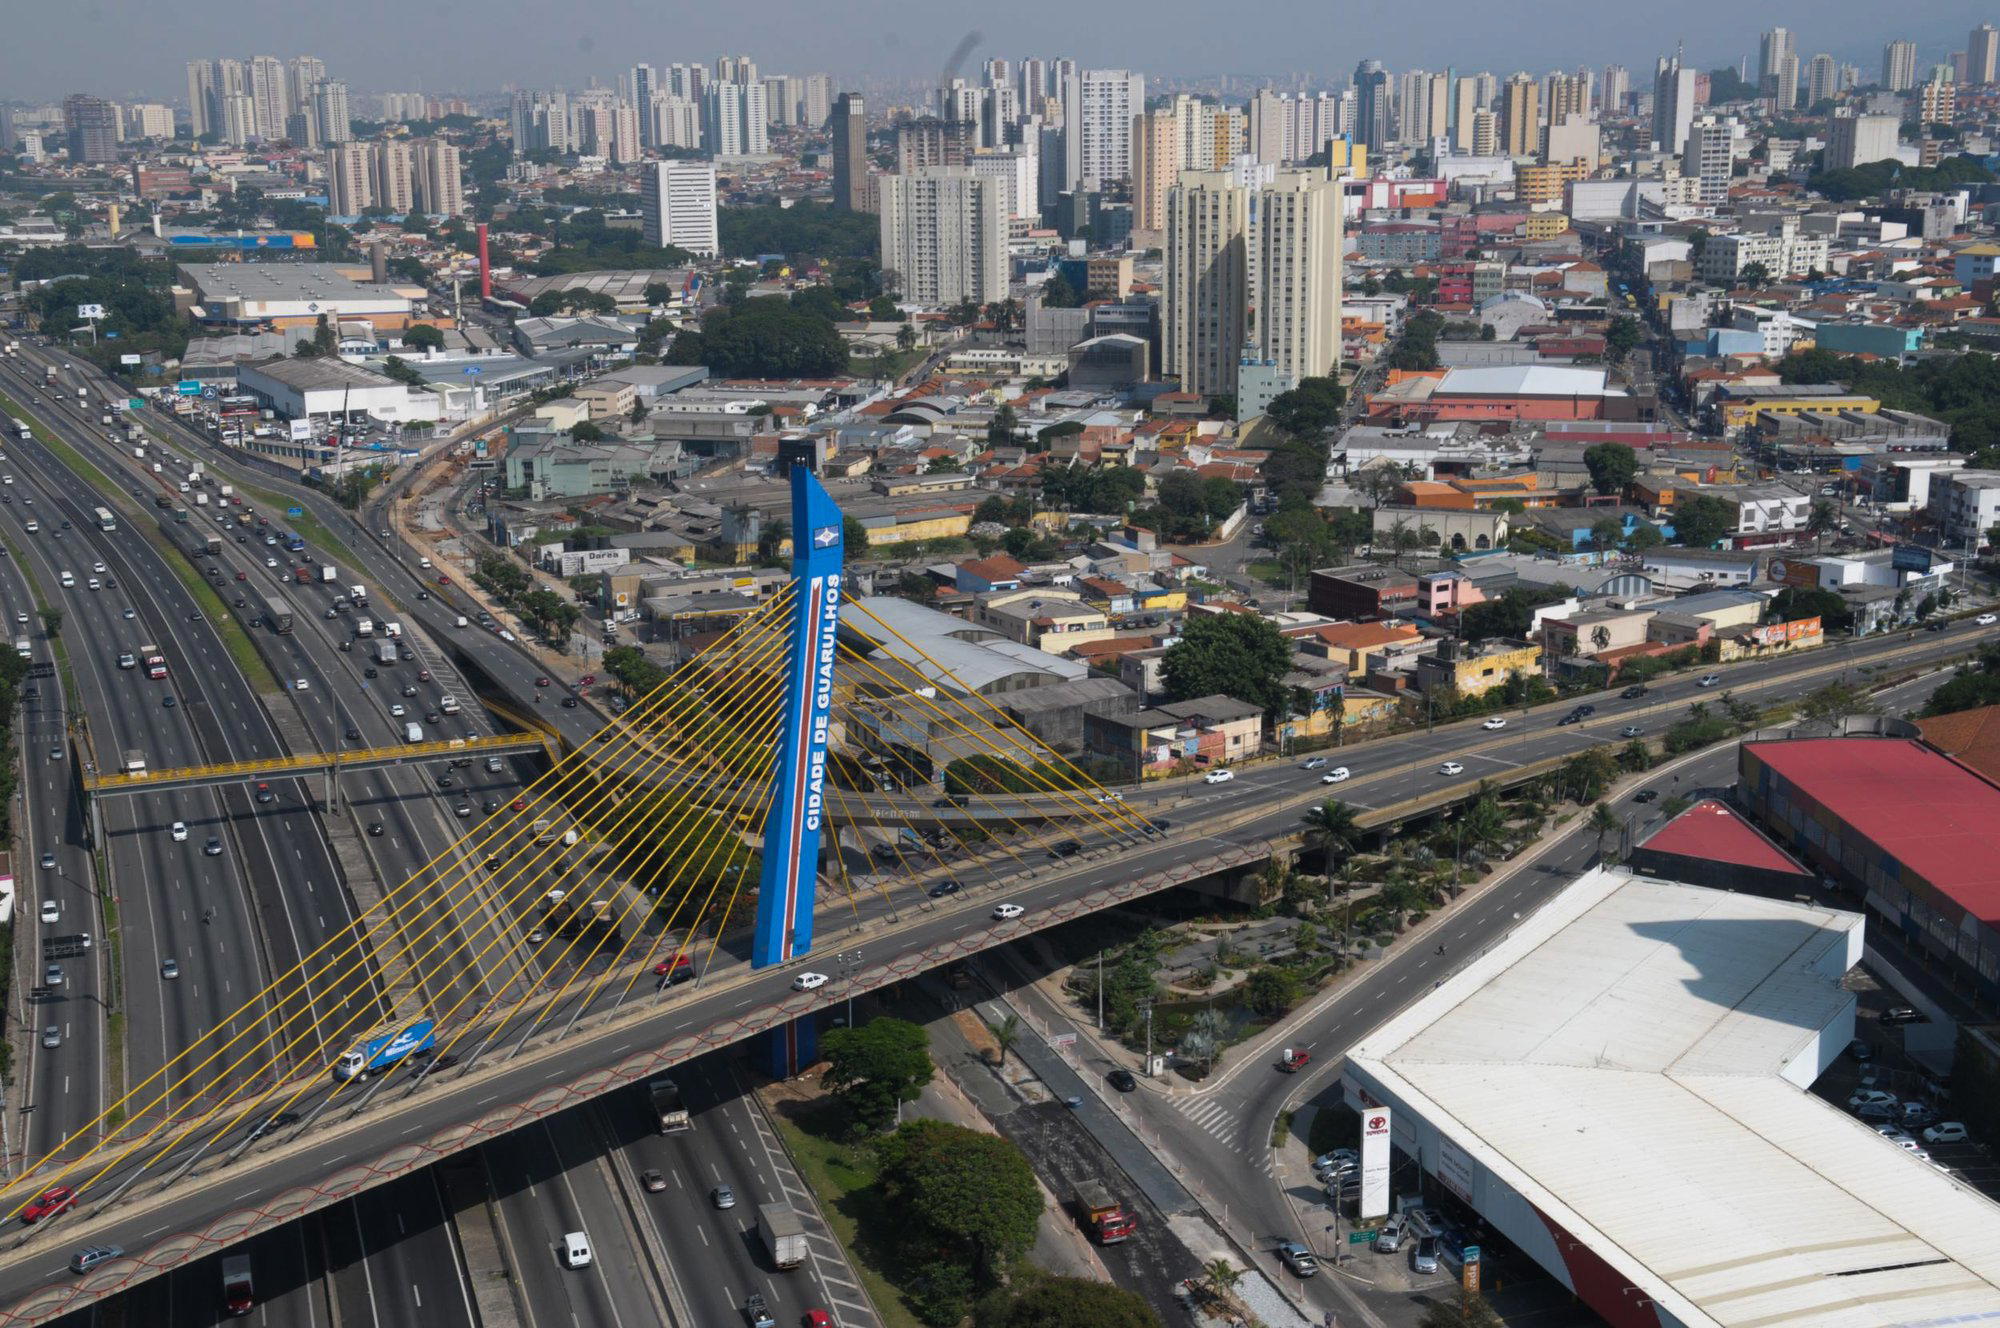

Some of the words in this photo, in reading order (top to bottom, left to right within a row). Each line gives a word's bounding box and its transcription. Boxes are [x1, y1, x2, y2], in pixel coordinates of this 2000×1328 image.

[817, 574, 840, 709] GUARULHOS
[814, 715, 828, 745] DE
[807, 751, 825, 831] CIDADE
[1365, 1129, 1389, 1137] TOYOTA
